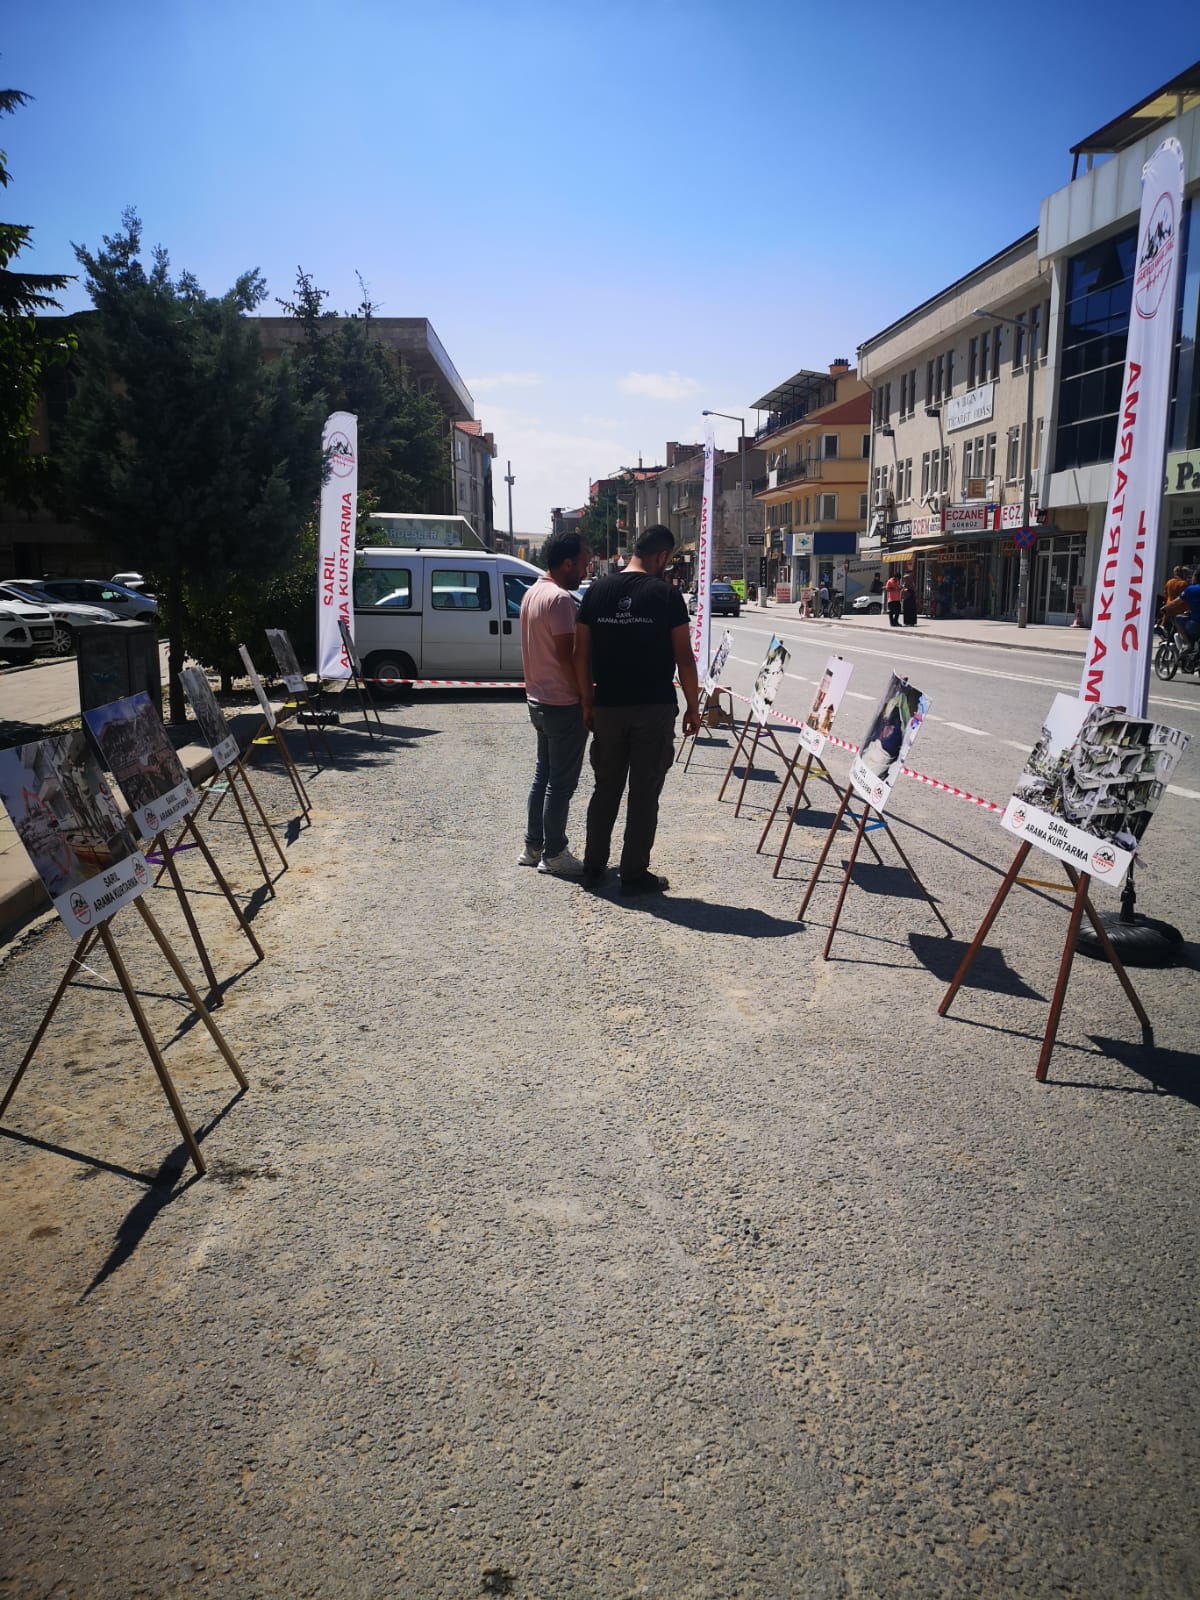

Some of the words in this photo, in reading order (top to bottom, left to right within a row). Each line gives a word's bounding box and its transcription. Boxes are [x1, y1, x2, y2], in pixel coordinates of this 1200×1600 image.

[946, 509, 984, 521] ECZANE
[338, 493, 353, 596] KURTARMA
[323, 552, 336, 607] SARIL
[1025, 823, 1047, 840] ARAMA
[1047, 834, 1089, 862] KURTARMA
[1048, 821, 1069, 839] SARIL
[93, 892, 116, 912] ARAMA
[114, 877, 139, 899] KURTARMA
[103, 872, 121, 888] SARIL
